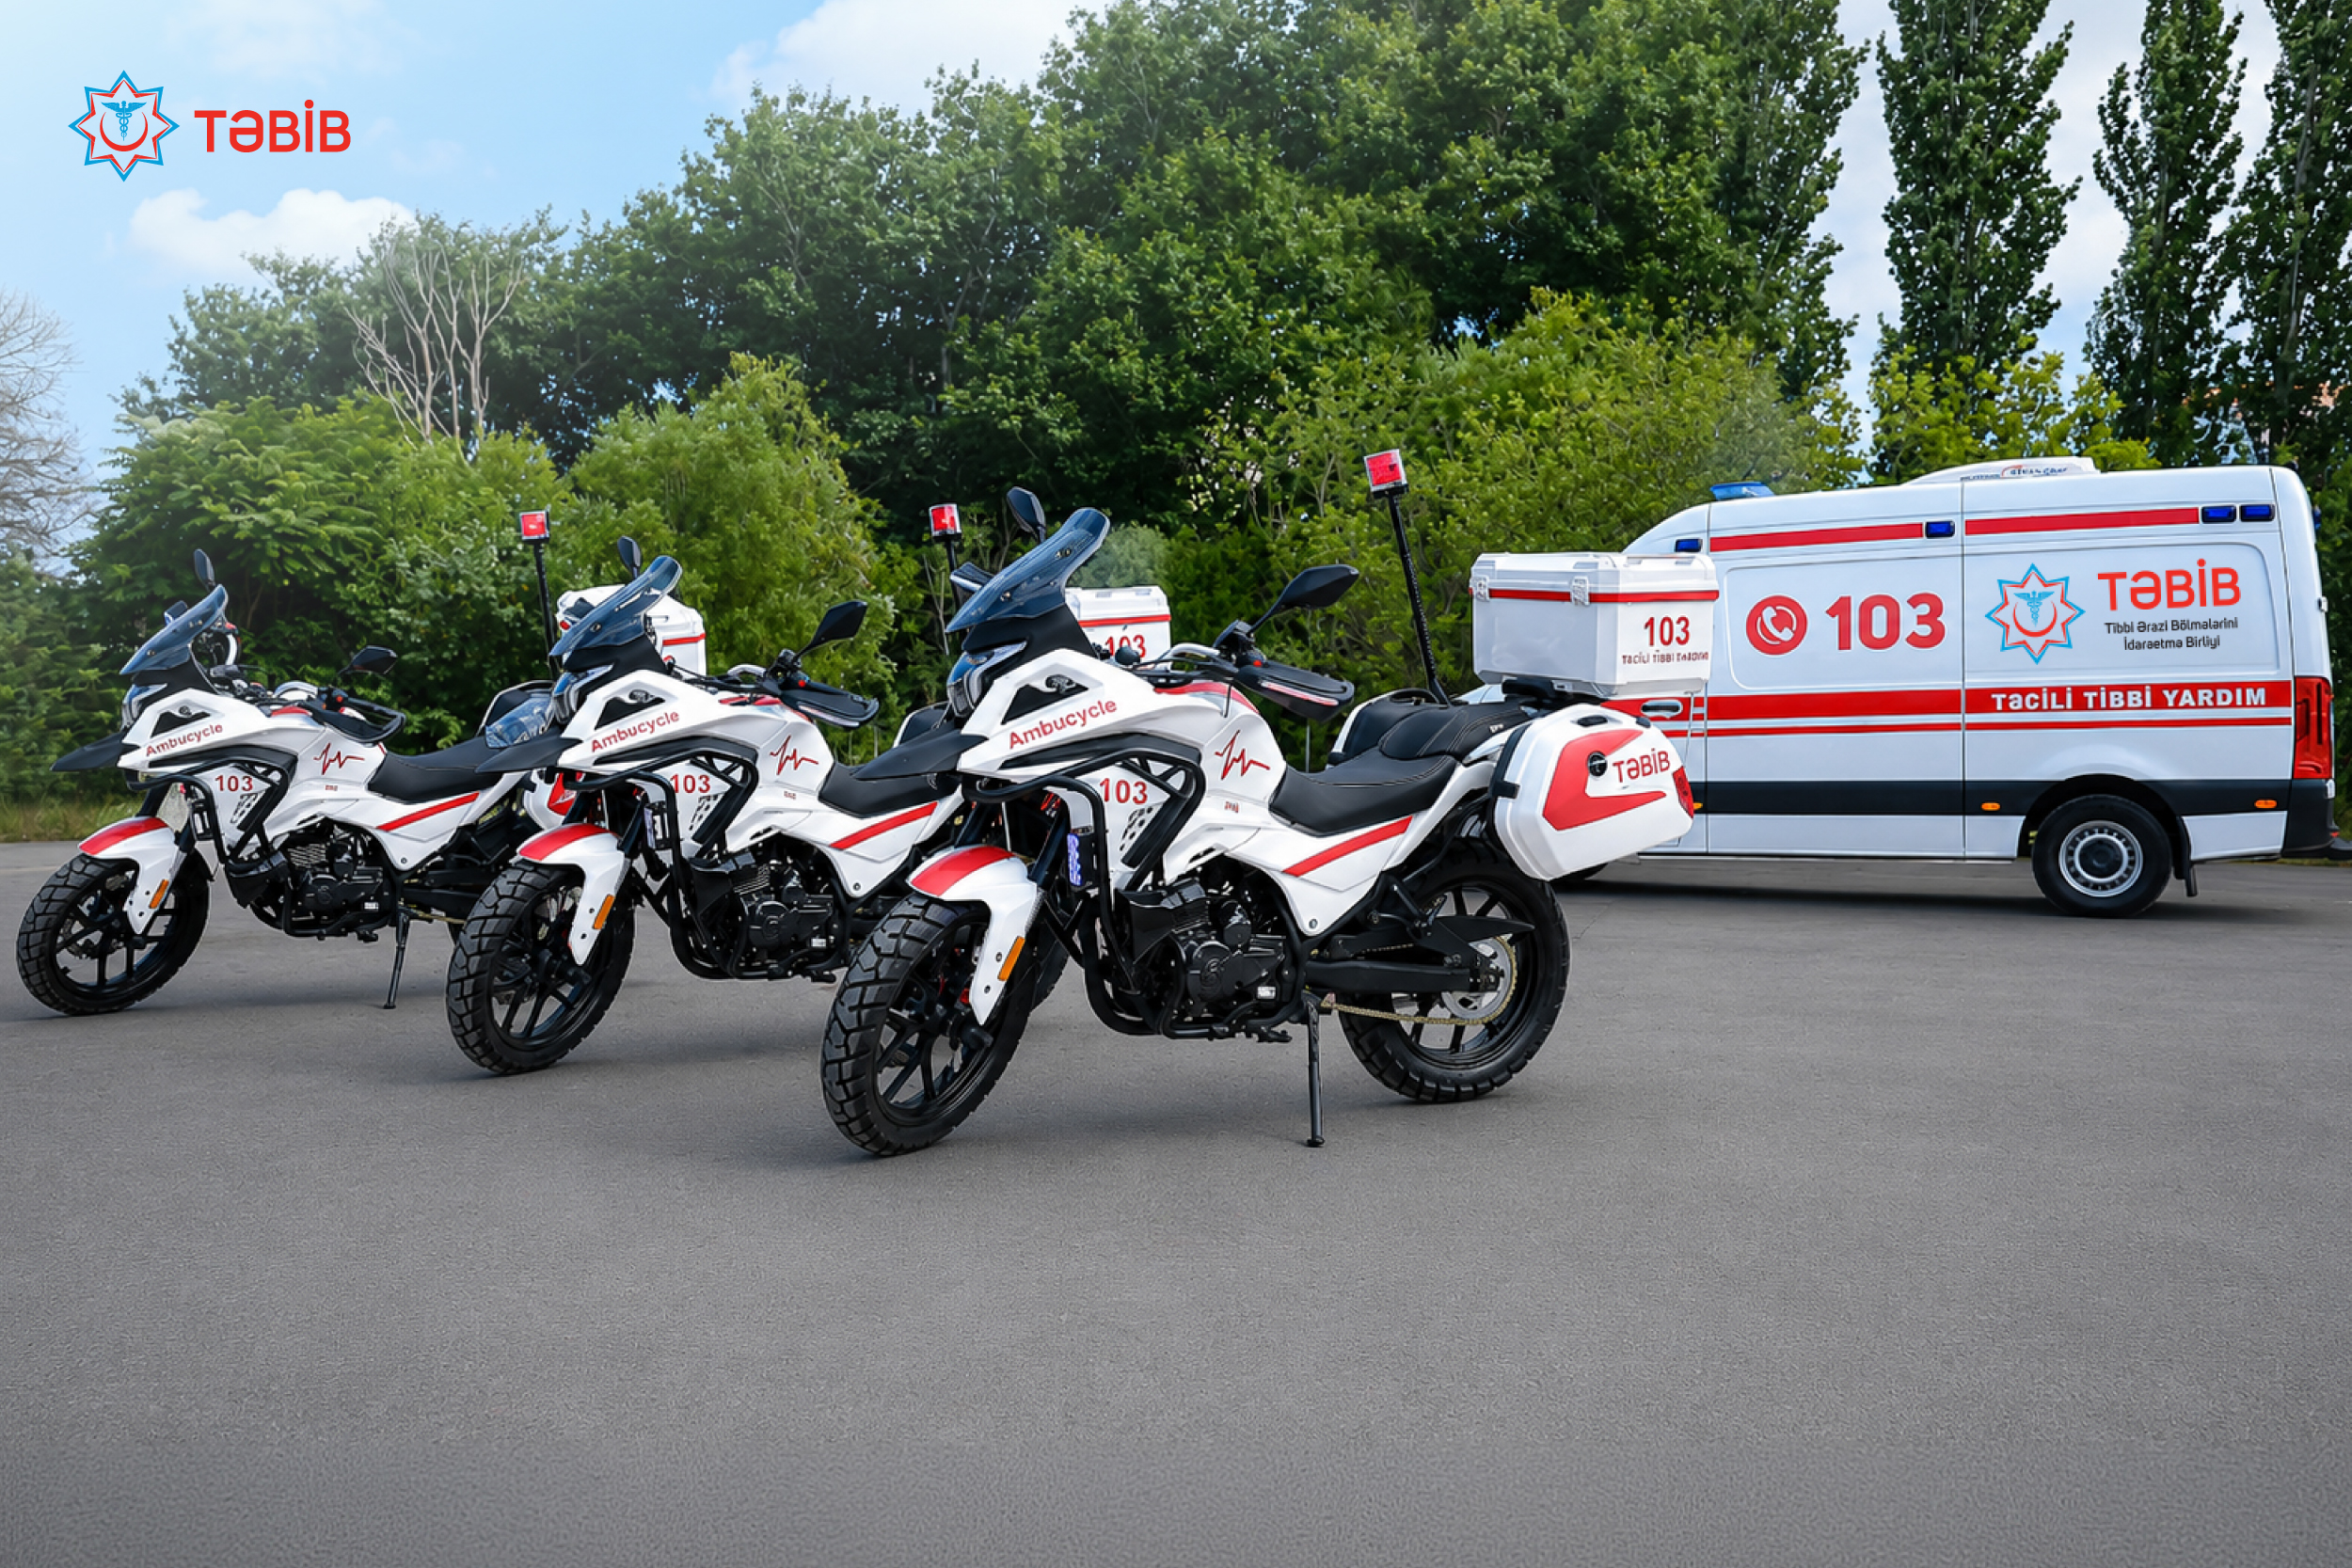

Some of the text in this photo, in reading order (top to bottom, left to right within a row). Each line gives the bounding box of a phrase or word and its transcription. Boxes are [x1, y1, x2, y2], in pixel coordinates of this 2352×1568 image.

[2097, 558, 2242, 611] TƏBİB
[1644, 616, 1691, 647] 103
[1825, 592, 1946, 651] 103
[2104, 621, 2135, 635] Tibbi
[1991, 685, 2266, 711] TƏCİLİ TİBBİ YARDIM
[146, 723, 223, 756] Ambucycle
[591, 711, 680, 752] Ambucycle
[1009, 700, 1118, 750] Ambucycle
[1612, 747, 1671, 784] TƏBİB
[215, 774, 254, 792] 103
[670, 773, 711, 794] 103
[1099, 777, 1149, 804] 103
